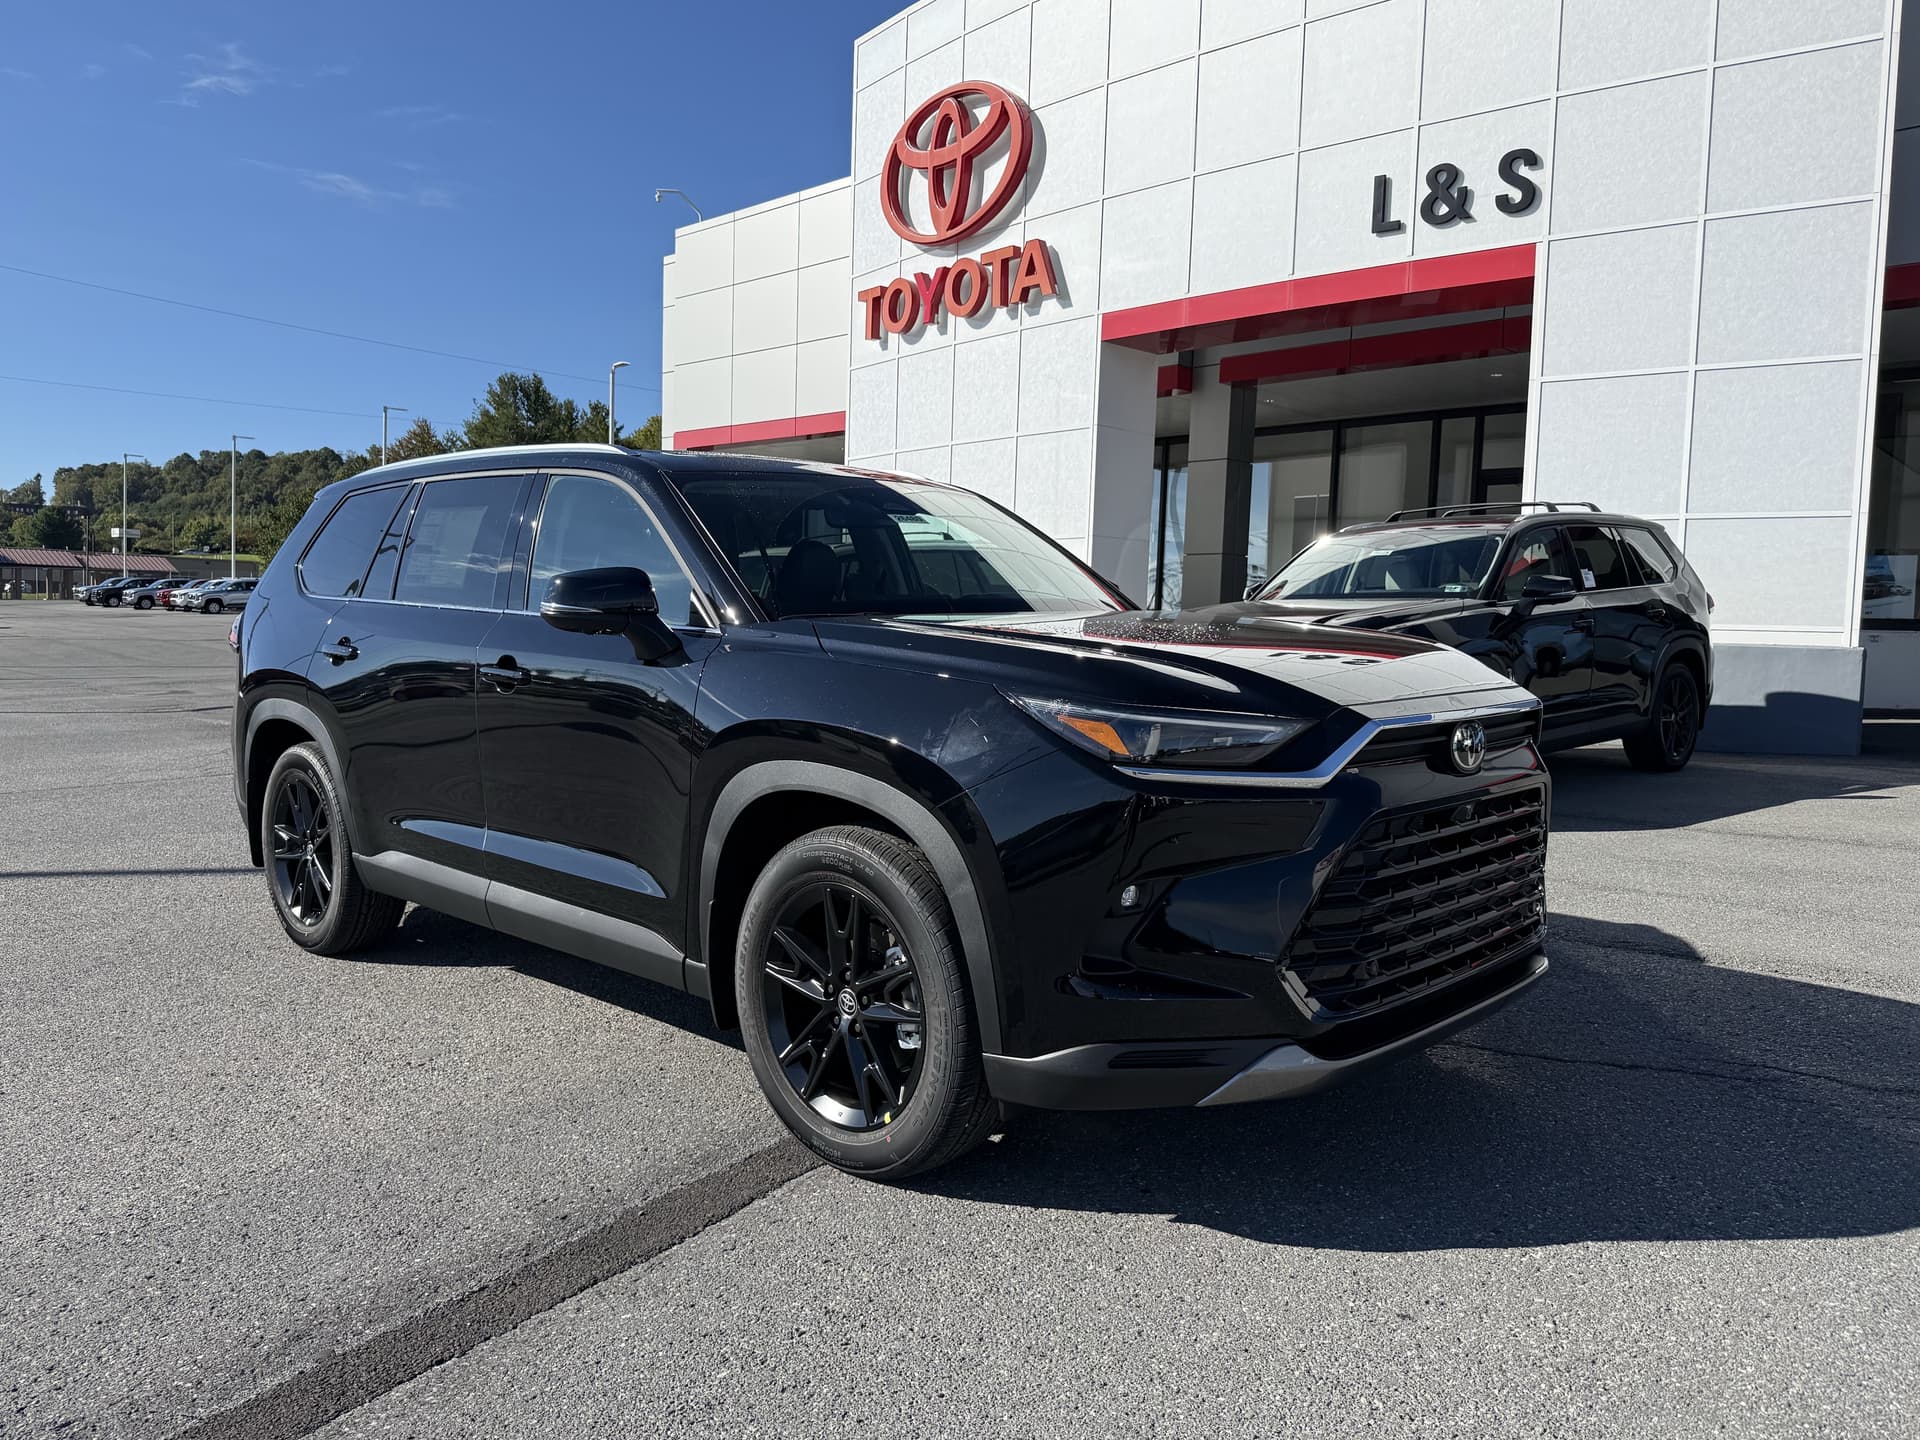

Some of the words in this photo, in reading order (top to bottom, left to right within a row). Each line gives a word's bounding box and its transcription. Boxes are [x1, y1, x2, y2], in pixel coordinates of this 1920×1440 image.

[1371, 174, 1402, 234] L
[1420, 162, 1473, 225] &
[1495, 148, 1539, 214] S
[858, 238, 1057, 341] TOYOTA
